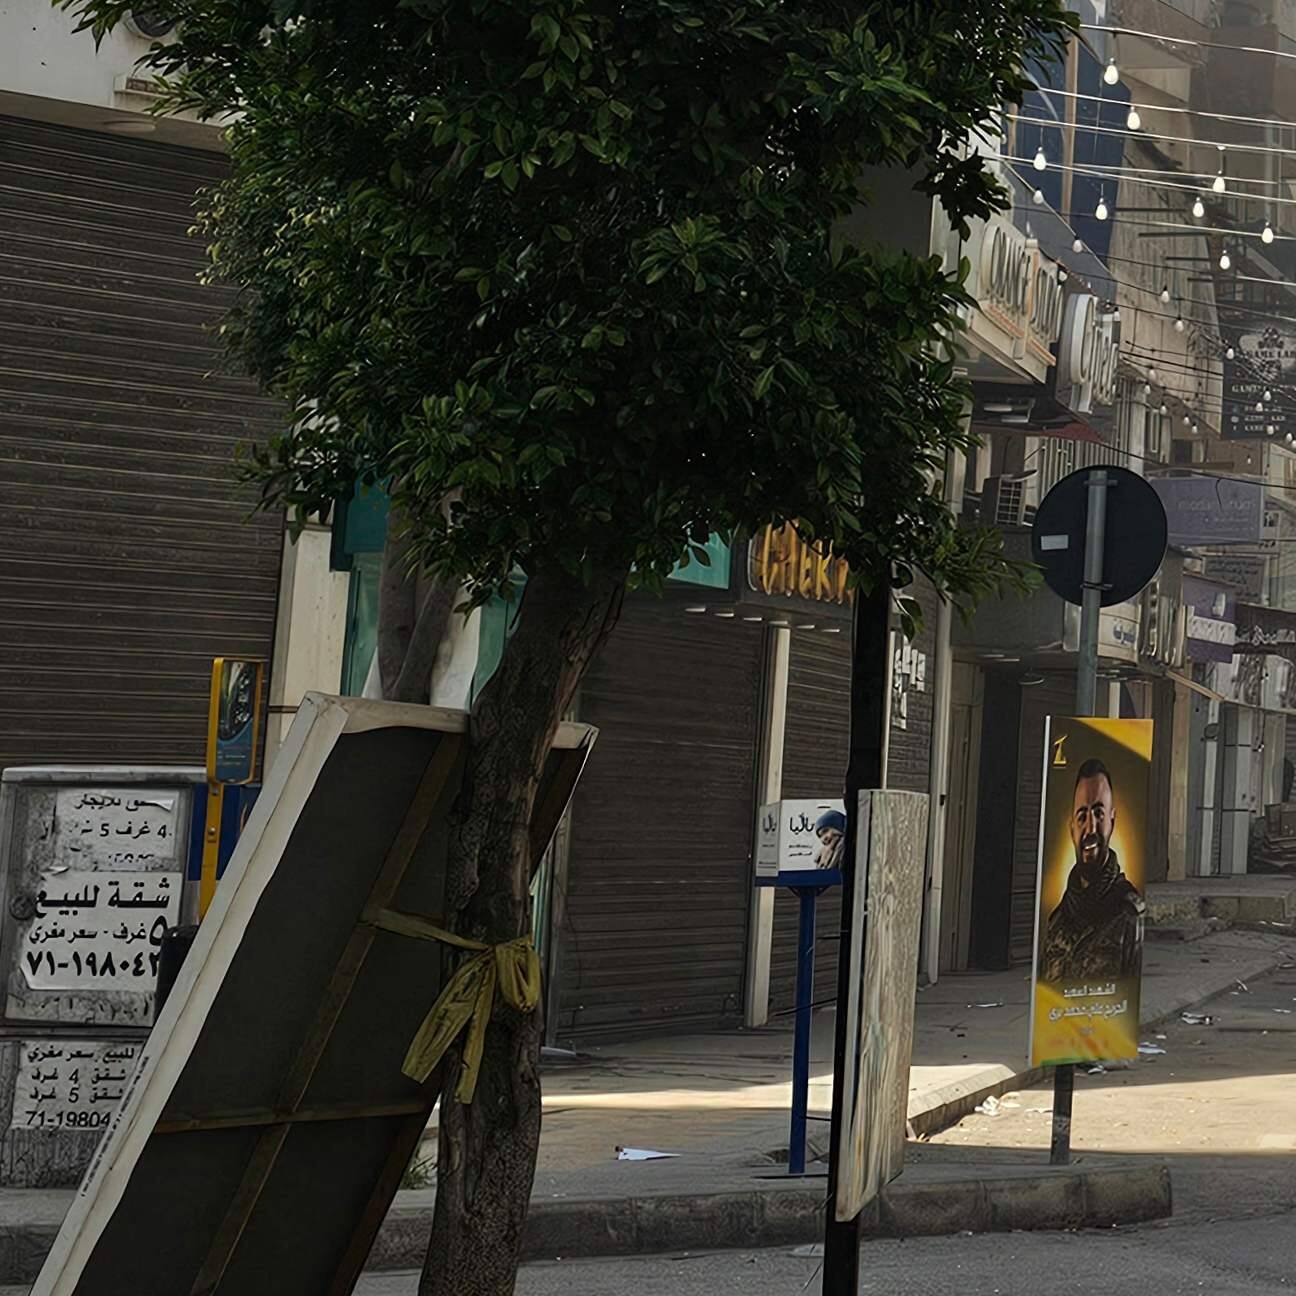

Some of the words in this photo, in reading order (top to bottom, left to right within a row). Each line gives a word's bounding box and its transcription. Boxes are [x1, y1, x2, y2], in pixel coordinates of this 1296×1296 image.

[99, 823, 110, 838] 5
[115, 820, 151, 840] غرف
[34, 884, 101, 919] للبيع
[107, 877, 171, 909] شقة
[28, 922, 66, 945] مغري
[67, 928, 98, 944] سعر
[112, 922, 148, 945] غرف
[27, 1045, 63, 1064] مغري
[102, 1047, 135, 1065] للبيع
[68, 1069, 80, 1085] 4
[67, 1087, 80, 1104] 5
